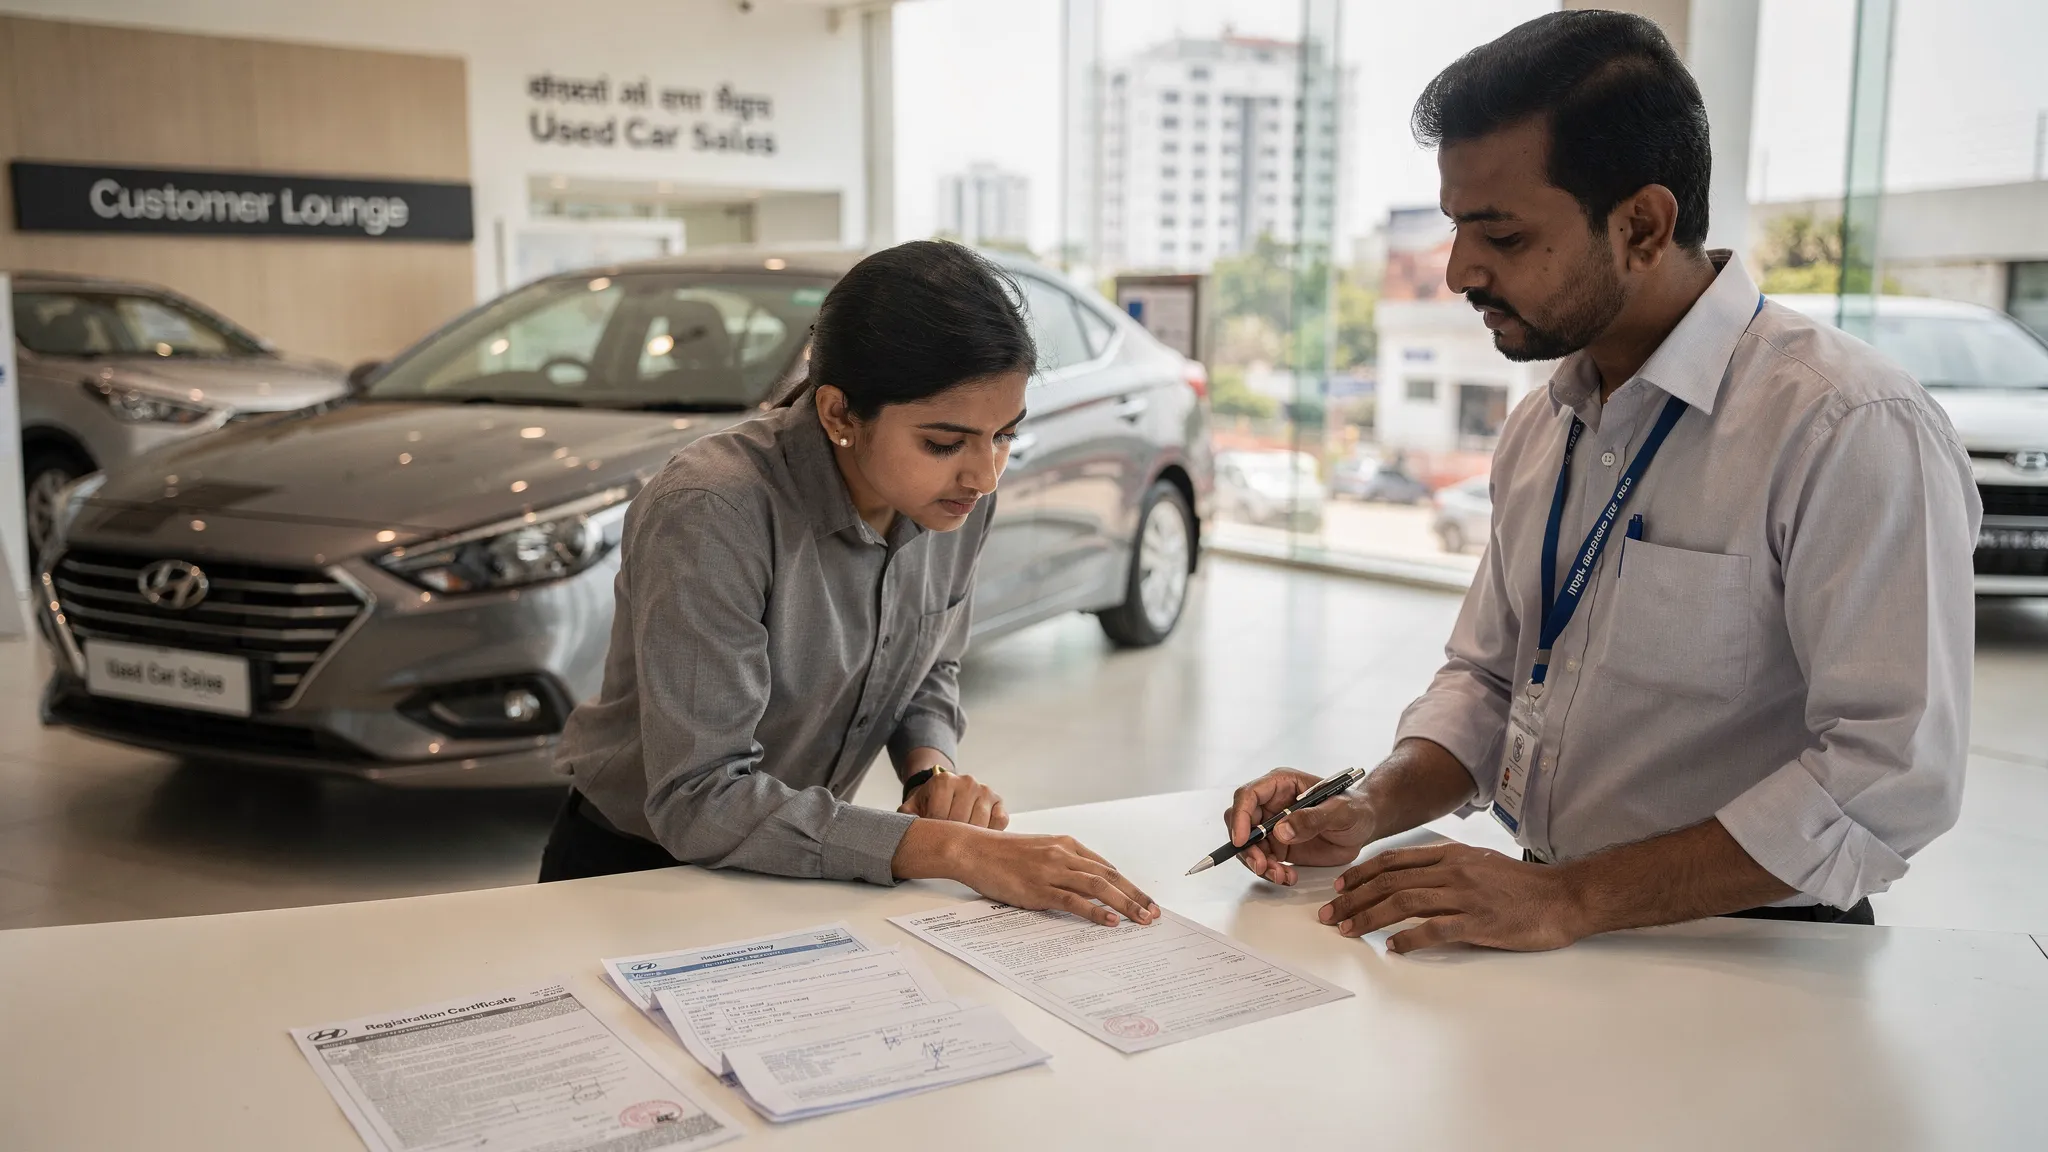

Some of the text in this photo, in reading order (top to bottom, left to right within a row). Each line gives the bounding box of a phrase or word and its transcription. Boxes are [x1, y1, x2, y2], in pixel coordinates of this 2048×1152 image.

[529, 111, 614, 147] Used
[624, 117, 678, 148] Car
[90, 178, 409, 236] Customer Lounge
[365, 1010, 447, 1031] Registration
[447, 996, 517, 1015] Certificate
